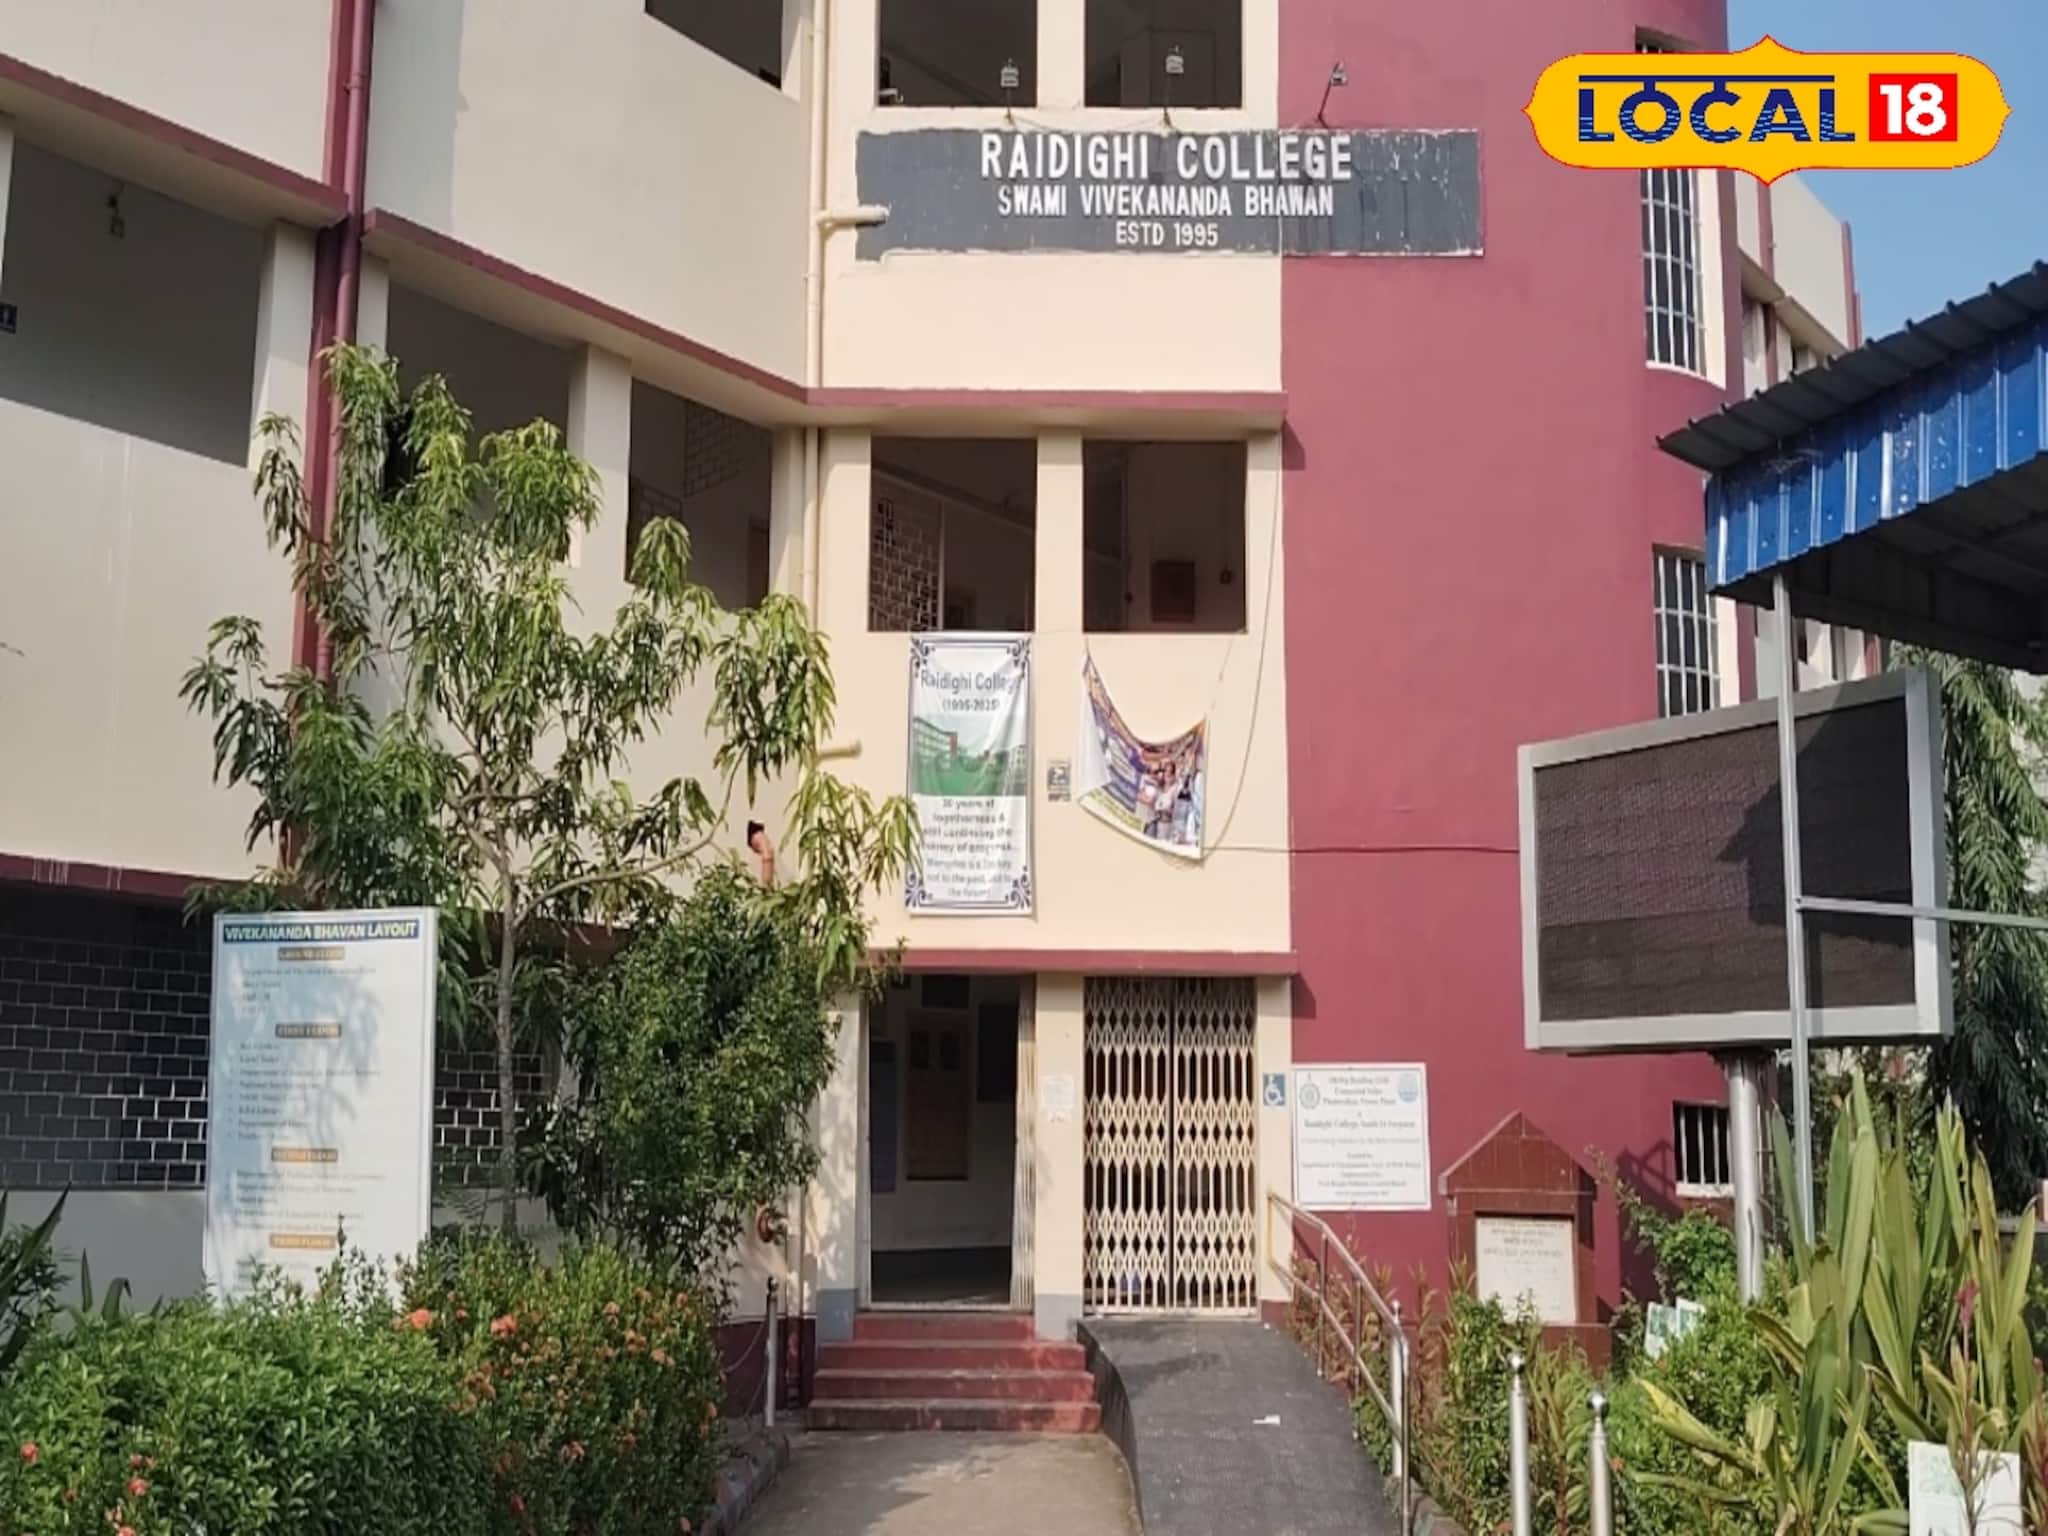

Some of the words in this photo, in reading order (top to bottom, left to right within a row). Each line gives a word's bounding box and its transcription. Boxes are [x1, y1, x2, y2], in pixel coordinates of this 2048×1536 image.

[981, 134, 1149, 180] RAIDIGHI
[1177, 135, 1352, 180] COLLEGE
[998, 187, 1067, 216] SWAMI
[1080, 186, 1232, 216] VIVEKANANDA
[1245, 185, 1334, 216] BHAWAN
[1116, 221, 1164, 246] ESTD
[1173, 221, 1218, 246] 1995
[921, 669, 972, 695] Raidighi
[225, 926, 311, 940] VIVEKANANDA
[314, 924, 363, 939] BHAVAN
[367, 922, 416, 937] LAYOUT
